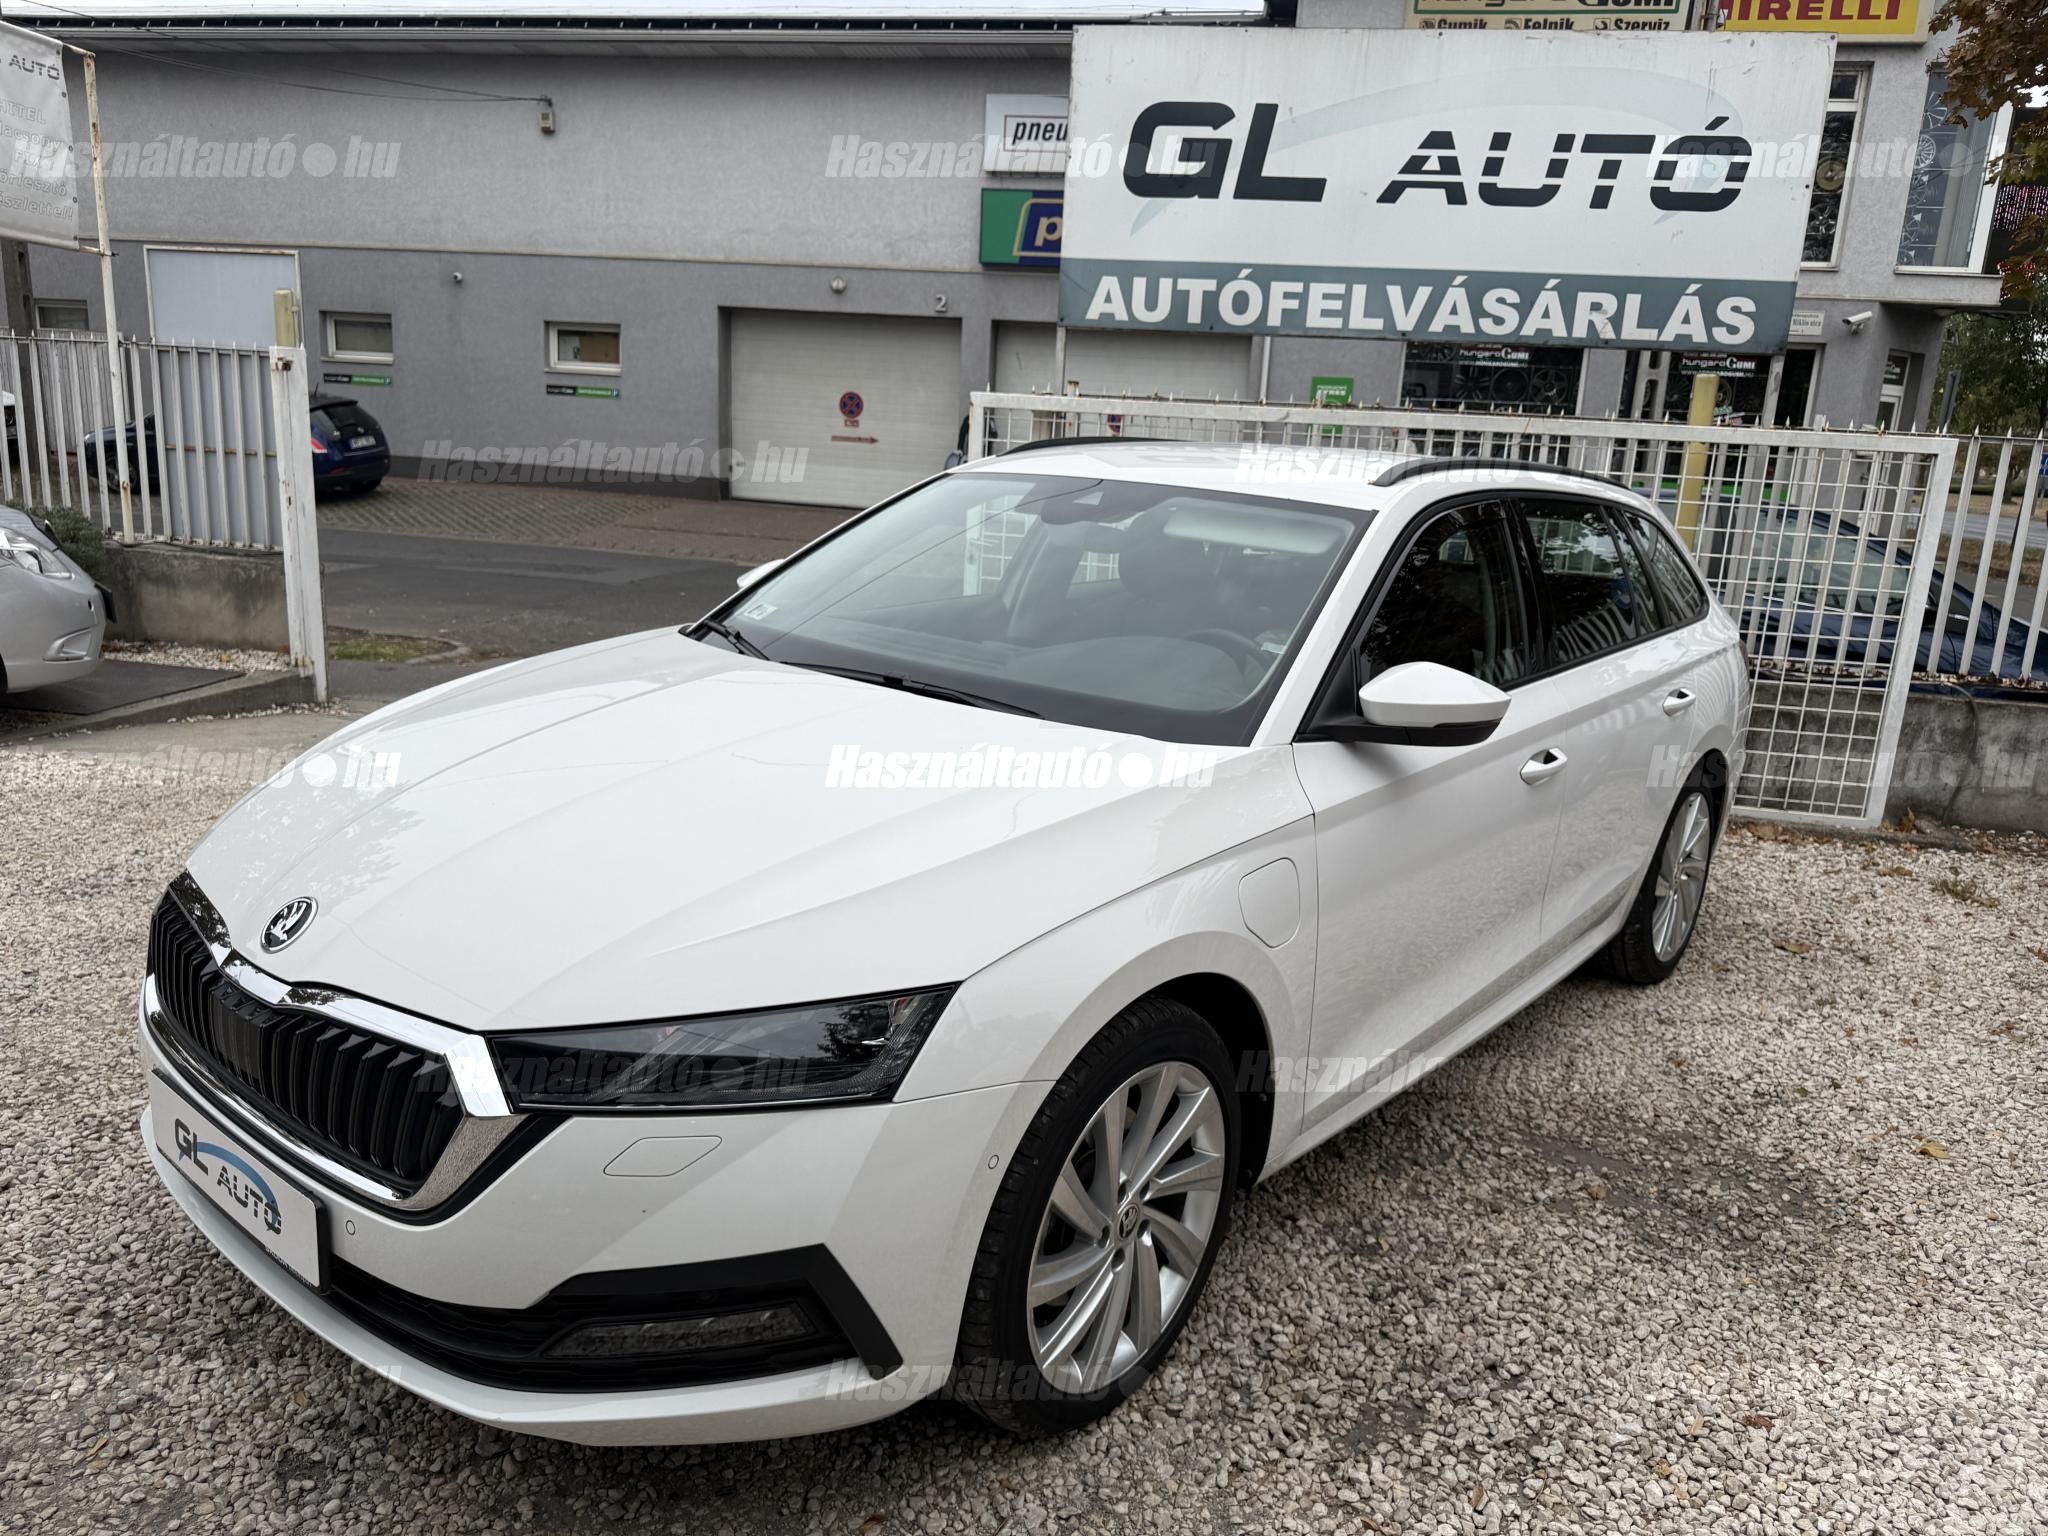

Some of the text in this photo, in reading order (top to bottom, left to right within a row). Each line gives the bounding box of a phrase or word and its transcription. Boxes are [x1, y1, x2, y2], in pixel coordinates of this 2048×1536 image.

[1722, 0, 1900, 20] IRELLI
[1123, 101, 1752, 212] GL AUTÓ
[935, 295, 946, 311] 2
[1085, 268, 1757, 345] AUTÓFELVÁSÁRLÁS
[175, 1118, 281, 1235] GL AUTÓ
